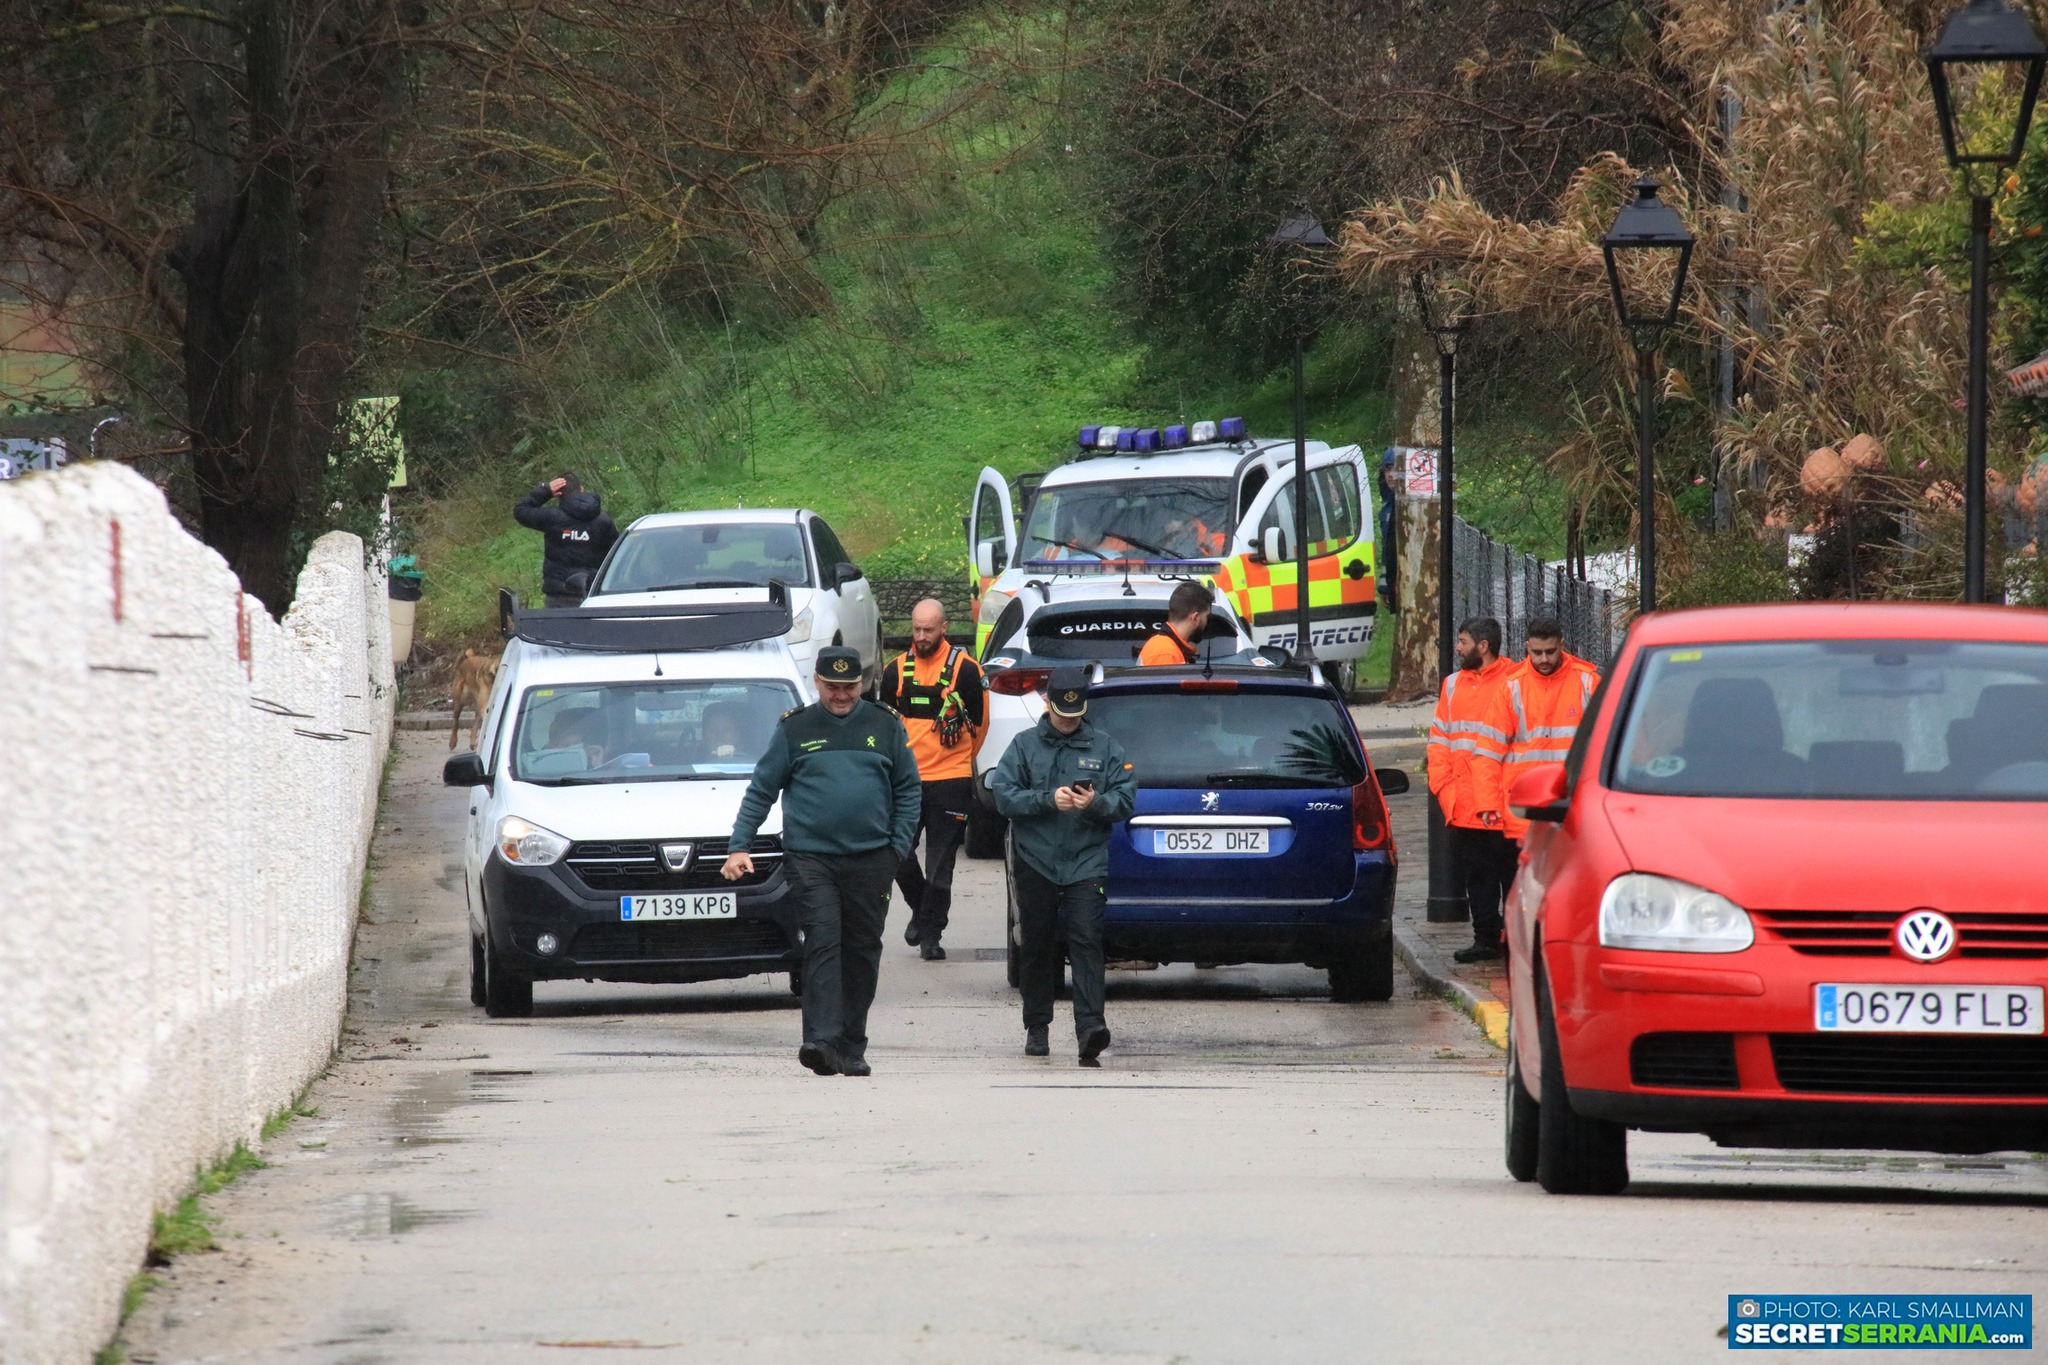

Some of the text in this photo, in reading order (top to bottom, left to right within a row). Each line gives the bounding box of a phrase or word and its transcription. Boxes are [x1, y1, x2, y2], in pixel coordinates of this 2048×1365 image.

[562, 529, 590, 541] FILA
[1060, 621, 1146, 635] GUARDIA
[1267, 625, 1374, 649] PRTECCI
[1167, 832, 1260, 850] 0552 DHZ
[636, 898, 686, 917] 7139
[694, 896, 731, 915] KPG
[1844, 991, 1942, 1024] 0679
[1955, 993, 2028, 1027] FLB
